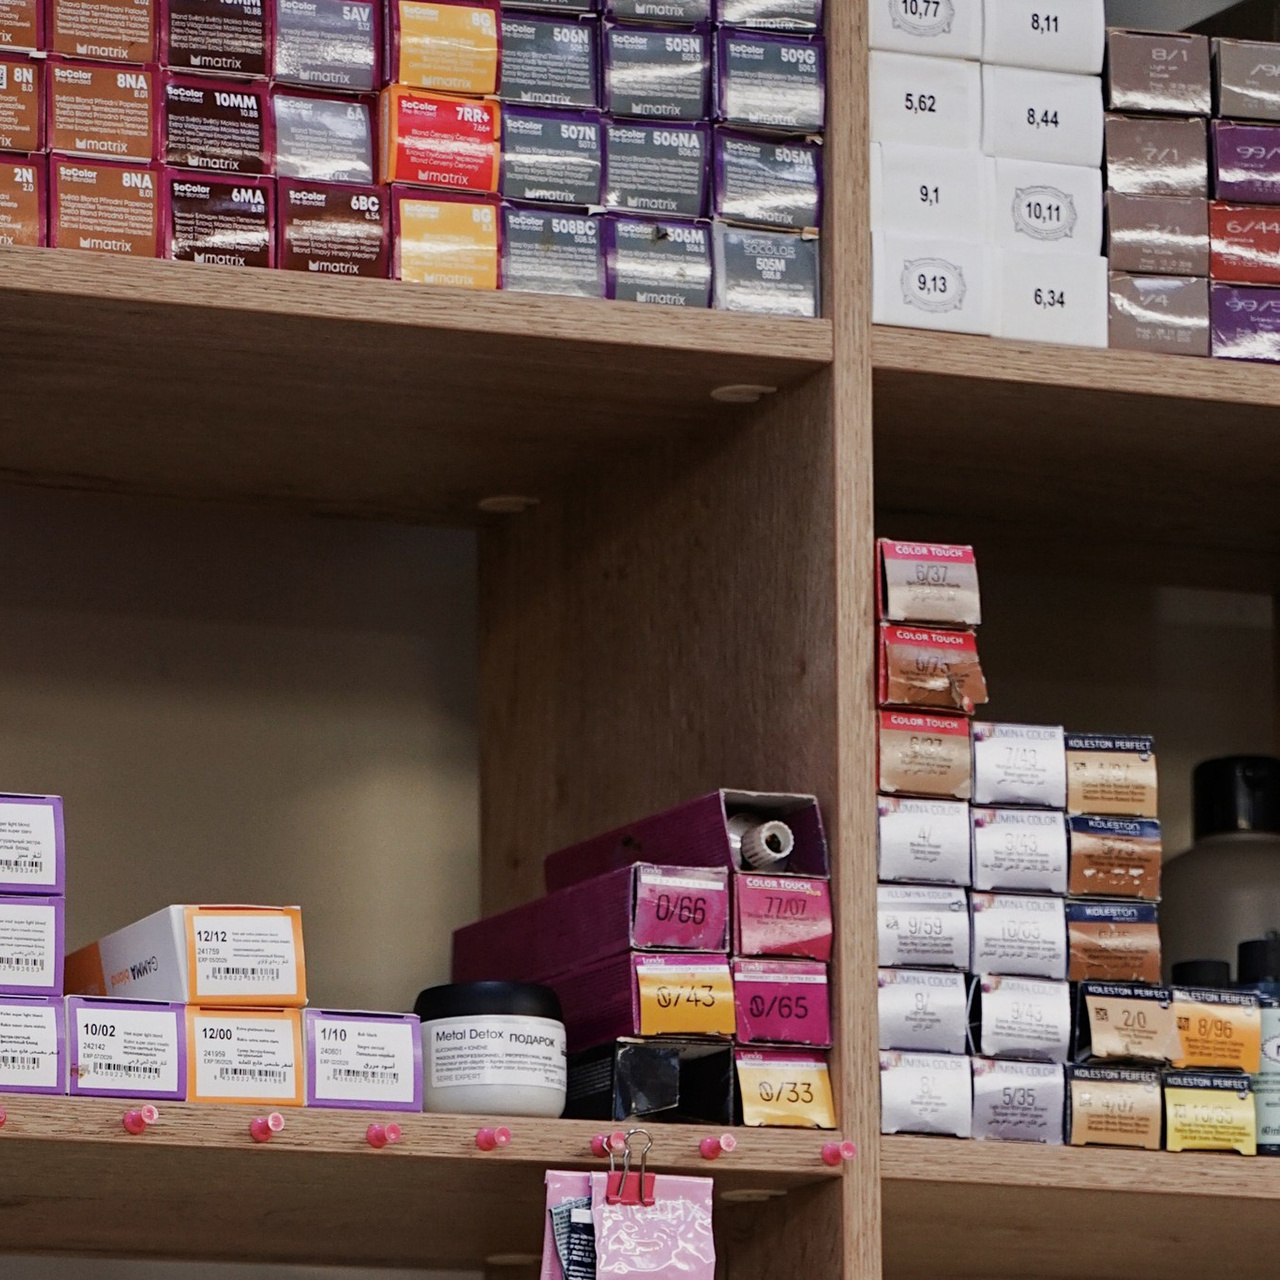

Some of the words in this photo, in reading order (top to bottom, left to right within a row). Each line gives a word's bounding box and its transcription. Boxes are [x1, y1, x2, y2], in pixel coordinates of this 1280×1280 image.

[343, 7, 369, 20] 5AV
[902, 0, 940, 19] 10,77
[1031, 14, 1059, 34] 8,11
[553, 28, 588, 43] 506N
[666, 38, 700, 52] 505N
[781, 49, 816, 64] 509G
[1151, 49, 1187, 61] 8/1
[13, 68, 33, 82] 8N
[55, 69, 92, 80] SoColor
[117, 74, 147, 89] 8NA
[22, 84, 32, 92] 8.0
[134, 90, 148, 98] 8.01
[215, 92, 258, 109] 10MM
[904, 93, 936, 113] 5,62
[456, 107, 490, 123] 7RR+
[1027, 108, 1059, 128] 8,44
[473, 124, 490, 132] 7.66+
[560, 125, 595, 141] 507N
[653, 132, 700, 149] 506NA
[14, 168, 33, 182] 2N
[123, 173, 152, 189] 8NA
[23, 184, 33, 192] 2.0
[920, 186, 939, 204] 9,1
[232, 189, 264, 203] 6MA
[351, 196, 379, 211] 6BC
[1026, 202, 1061, 222] 10,11
[552, 220, 595, 235] 508BC
[918, 275, 947, 293] 9,13
[1034, 290, 1064, 308] 6,34
[895, 546, 928, 556] COLOR
[931, 546, 963, 557] TOUCH
[916, 565, 948, 582] 6/37
[896, 631, 928, 641] COLOR
[932, 633, 963, 644] TOUCH
[891, 716, 923, 726] COLOR
[926, 718, 958, 729] TOUCH
[1068, 739, 1113, 750] KOLESTON
[1115, 740, 1151, 751] PERFECT
[747, 878, 778, 888] COLOR
[780, 880, 811, 890] TOUCH
[656, 894, 706, 924] 0/66
[765, 897, 806, 915] 77/07
[908, 917, 942, 934] 9/59
[197, 930, 227, 943] 12/12
[657, 986, 715, 1007] 0/43
[1088, 986, 1131, 996] KOLESTON
[1134, 989, 1169, 998] PERFECT
[749, 995, 808, 1018] 0/65
[1123, 1011, 1146, 1027] 2/0
[83, 1023, 116, 1037] 10/02
[202, 1027, 232, 1041] 12/00
[320, 1028, 346, 1042] 1/10
[436, 1030, 466, 1041] Metal
[470, 1029, 503, 1039] Detox
[1198, 1021, 1232, 1038] 8/96
[510, 1034, 555, 1047] ПОДАРОК
[759, 1082, 813, 1103] 0/33
[1002, 1088, 1035, 1106] 5/35
